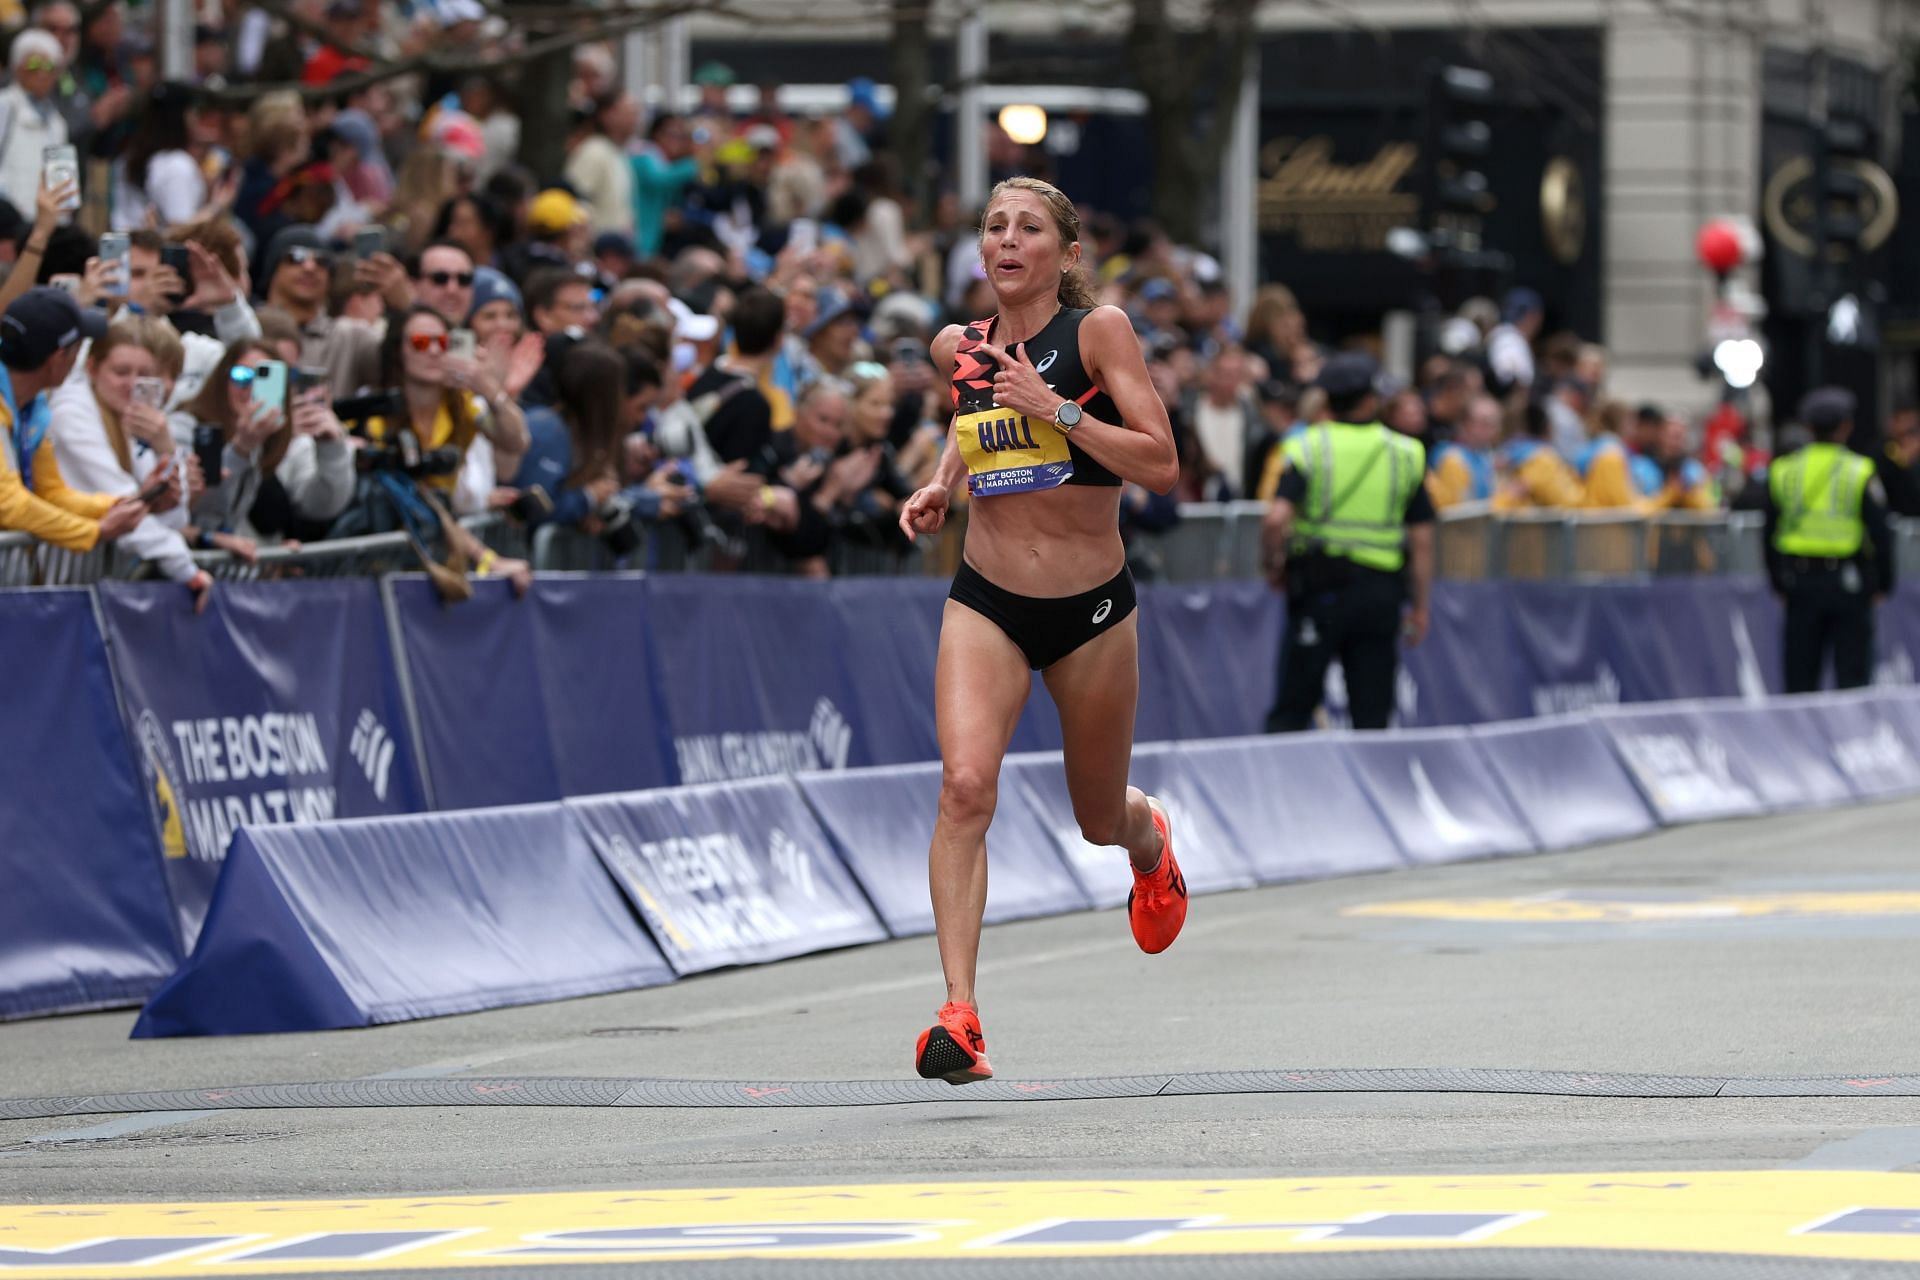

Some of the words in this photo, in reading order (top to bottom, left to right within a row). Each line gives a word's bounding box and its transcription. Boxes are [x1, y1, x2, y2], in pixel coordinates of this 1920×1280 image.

[977, 415, 1040, 454] HALL
[986, 476, 1034, 488] MARATHON
[1000, 468, 1033, 480] BOSTON
[172, 718, 229, 784] THE
[221, 711, 329, 780] BOSTON
